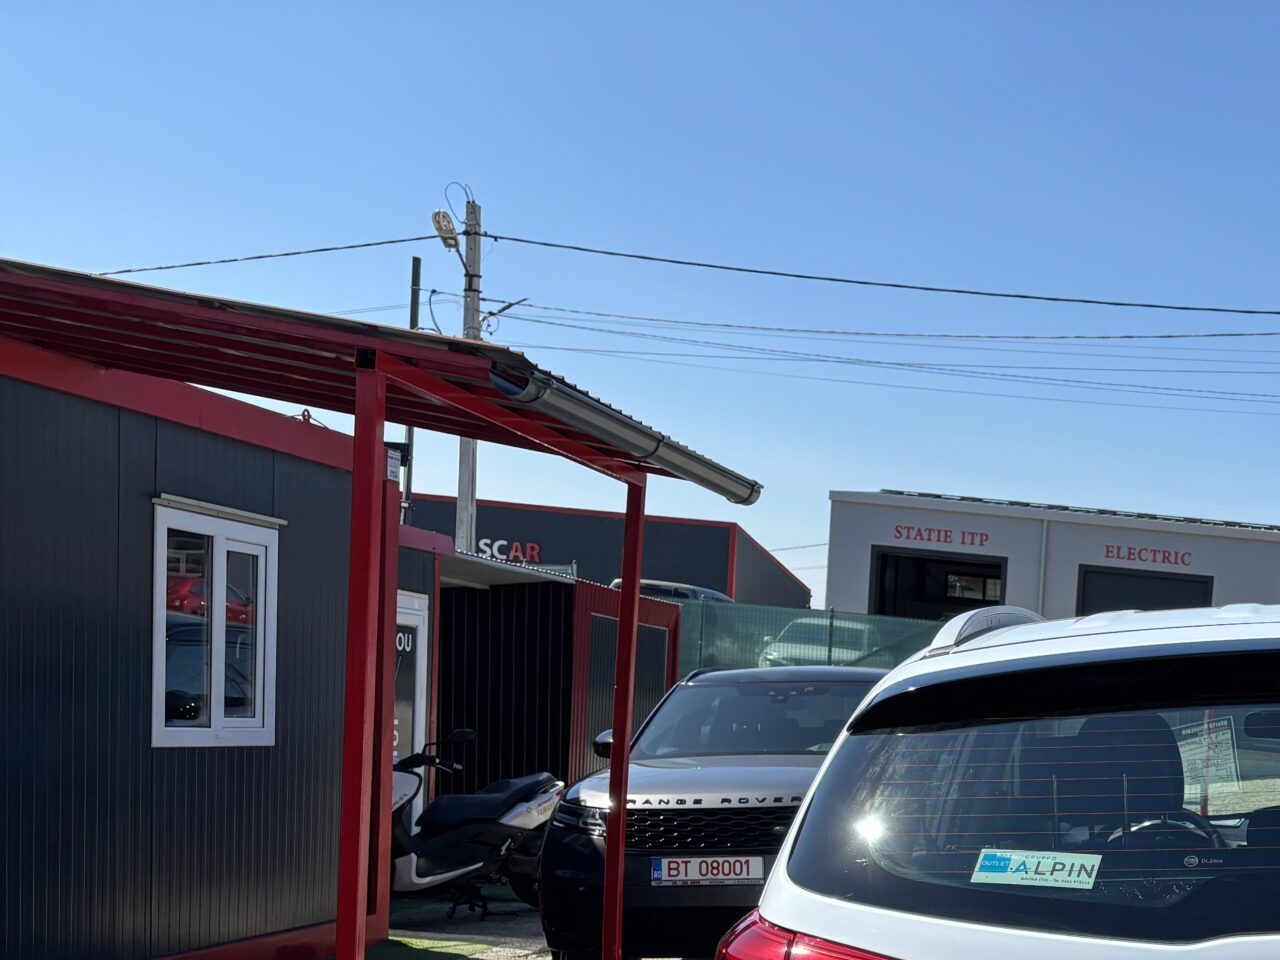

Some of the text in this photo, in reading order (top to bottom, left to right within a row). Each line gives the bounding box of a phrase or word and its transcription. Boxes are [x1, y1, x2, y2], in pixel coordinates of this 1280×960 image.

[893, 525, 990, 547] STATIE ITP
[478, 538, 541, 563] SCAR
[1104, 544, 1192, 566] ELECTRIC
[720, 796, 803, 804] ROVER
[667, 859, 750, 878] BT 08001
